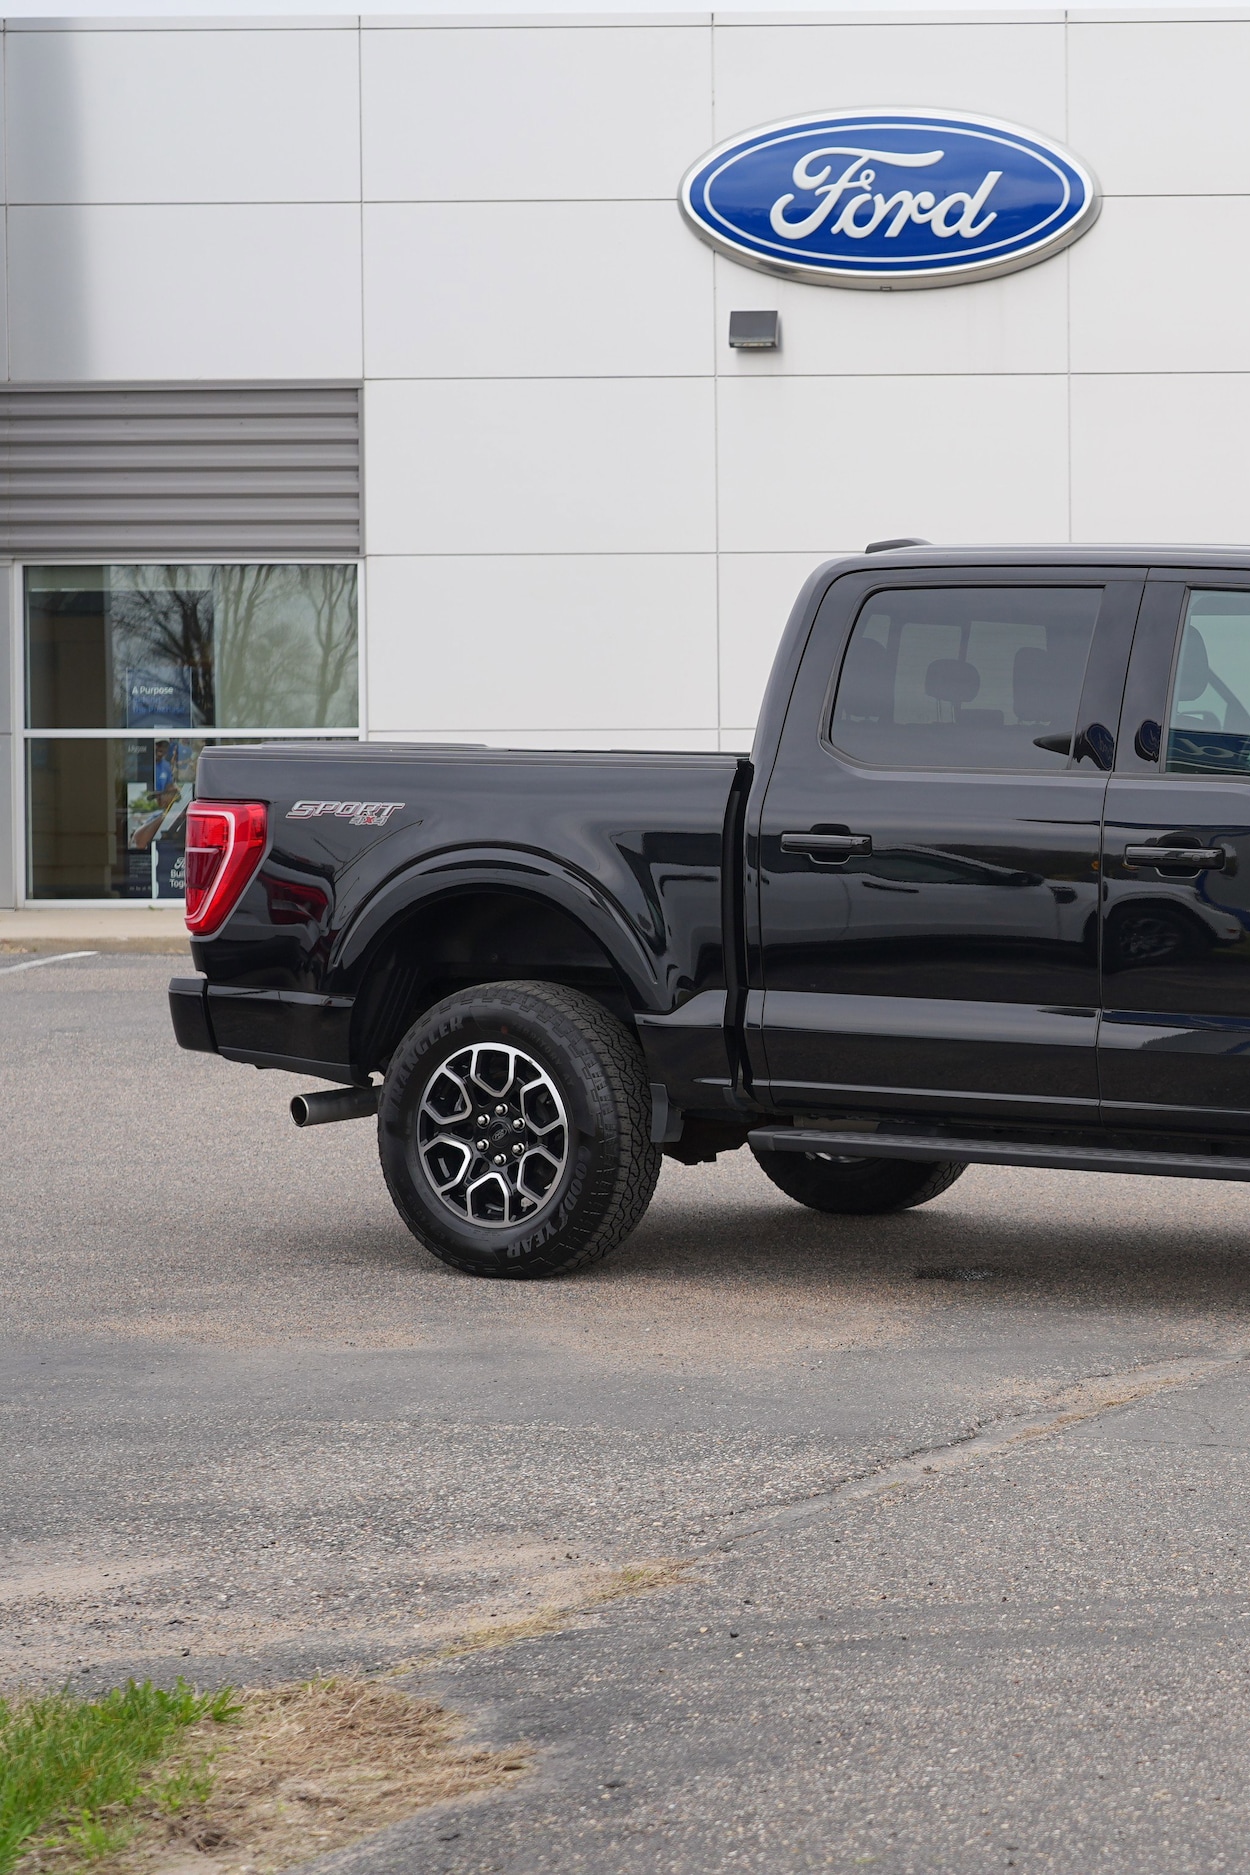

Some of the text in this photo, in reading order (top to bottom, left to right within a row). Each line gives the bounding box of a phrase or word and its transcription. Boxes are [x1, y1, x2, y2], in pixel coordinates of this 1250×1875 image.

[768, 146, 1004, 240] Ford
[131, 685, 174, 696] A Purpose
[285, 800, 406, 820] SPORT
